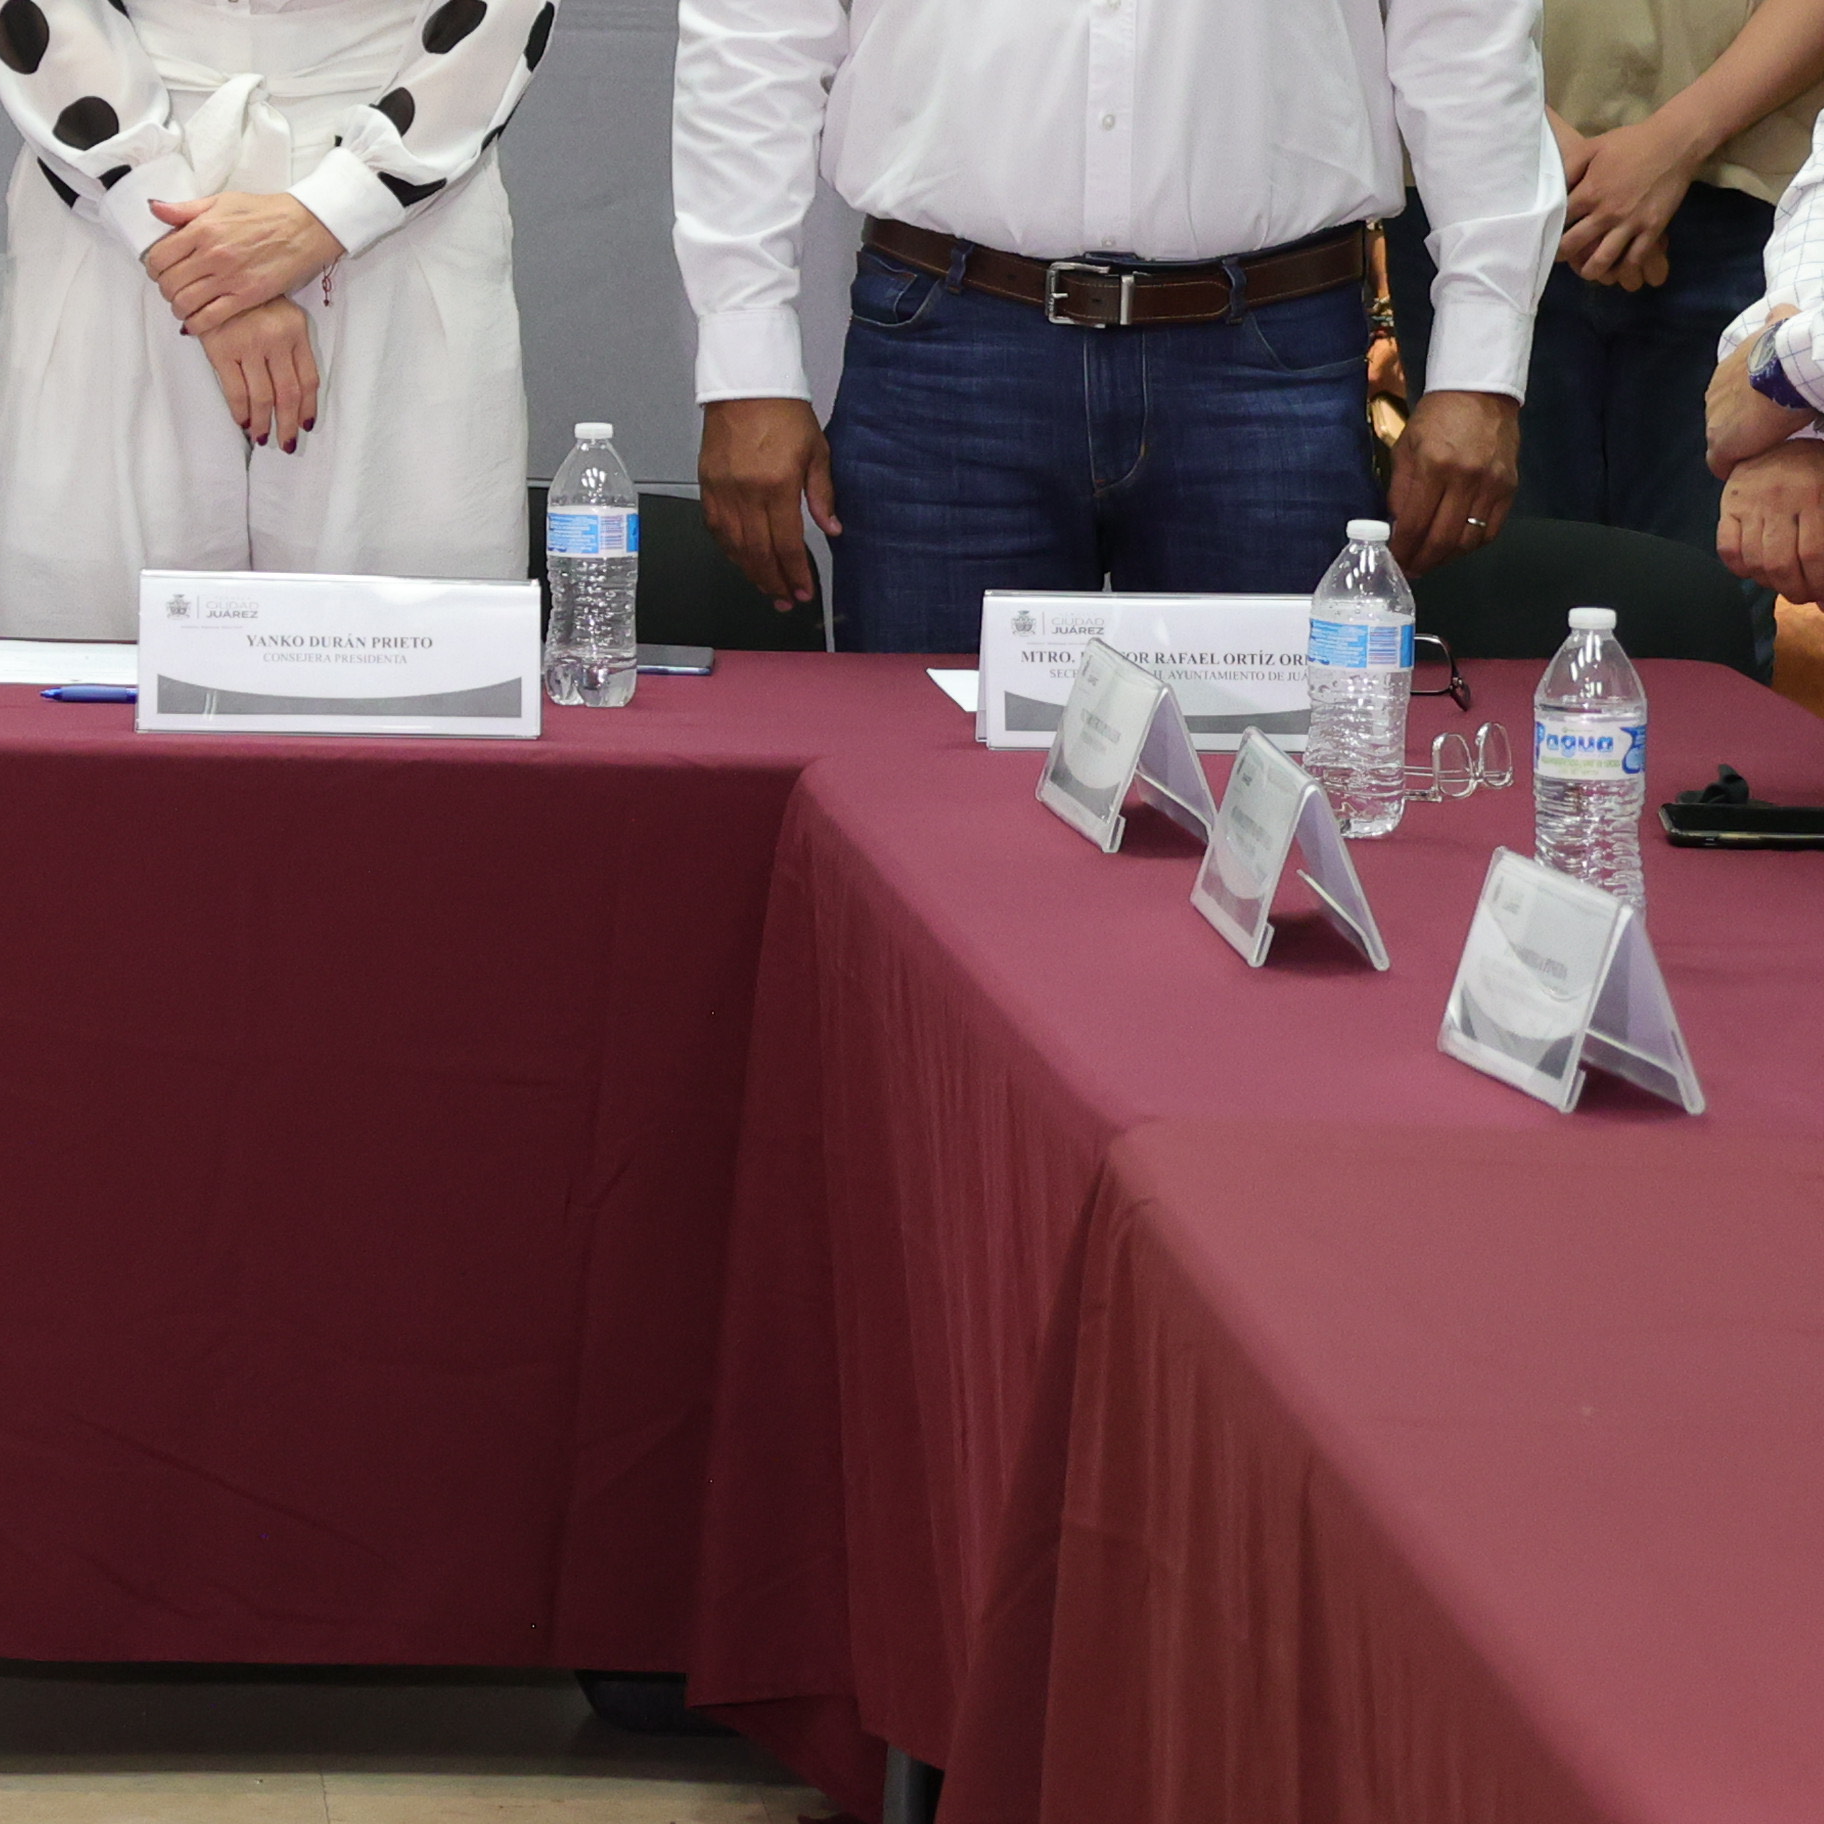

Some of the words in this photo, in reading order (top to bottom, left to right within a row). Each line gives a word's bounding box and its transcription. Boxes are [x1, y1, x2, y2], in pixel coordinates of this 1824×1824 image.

[205, 609, 259, 619] JUÁREZ
[1050, 625, 1105, 636] JUÁREZ
[245, 633, 306, 649] YANKO
[308, 631, 368, 649] DURÁN
[370, 635, 434, 650] PRIETO
[261, 652, 332, 665] CONSEJERA
[334, 652, 409, 665] PRESIDENTA
[1020, 650, 1076, 664] MTRO.
[1154, 651, 1220, 665] RAFAEL
[1222, 648, 1274, 666] ORTÍZ
[1166, 669, 1266, 681] AYUNTAMIENTO
[1267, 670, 1286, 682] DE
